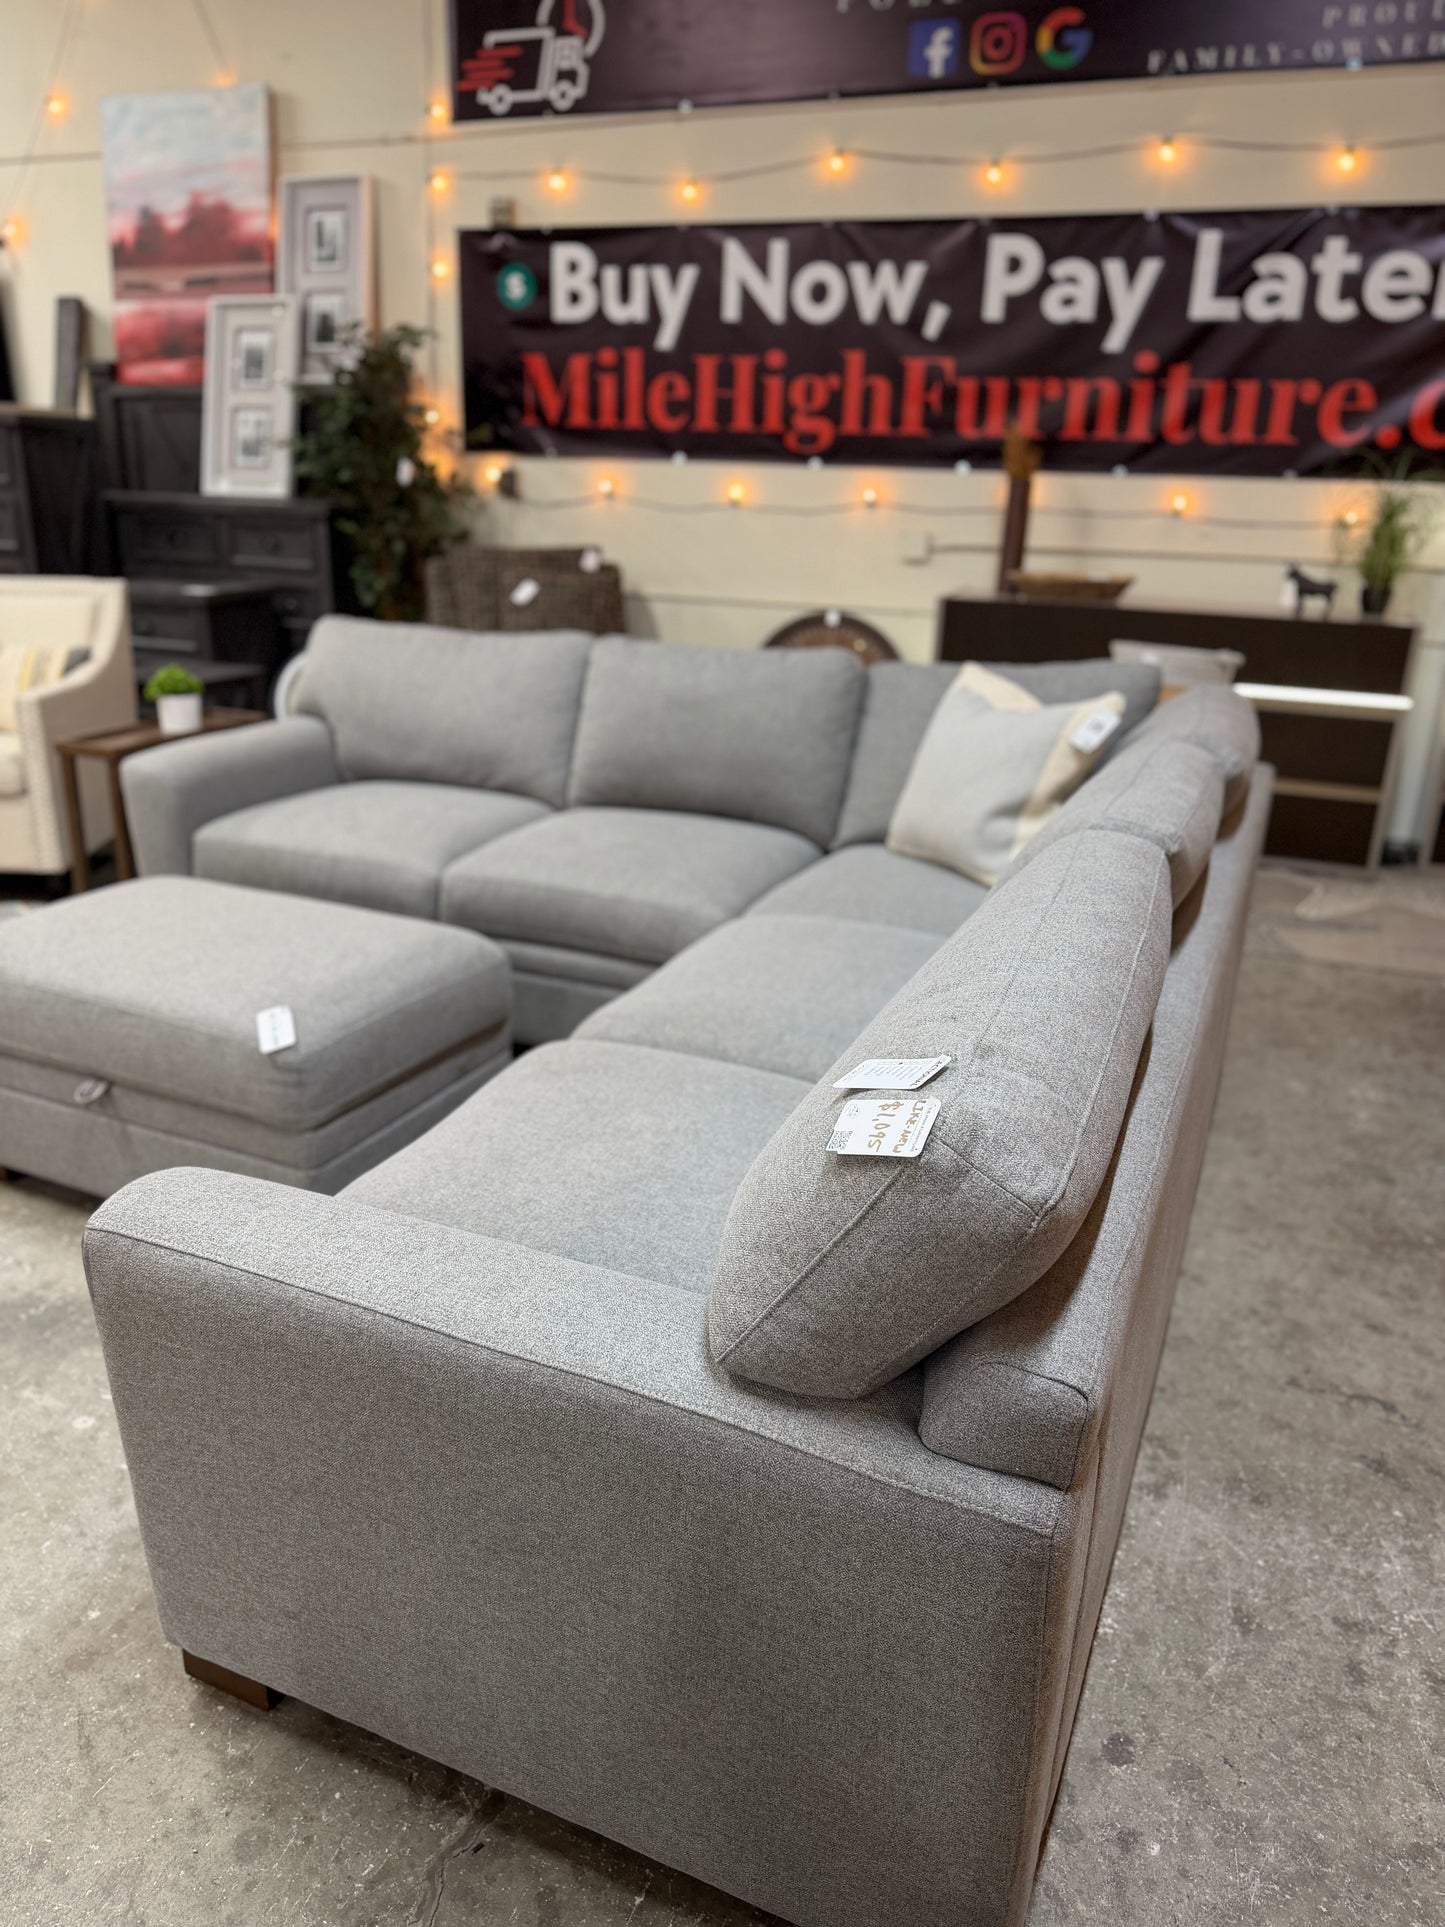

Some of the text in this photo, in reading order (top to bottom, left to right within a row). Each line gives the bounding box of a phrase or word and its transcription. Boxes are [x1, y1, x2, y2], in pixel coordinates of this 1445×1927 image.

[549, 240, 699, 352] Buy
[719, 236, 951, 342] Now,
[980, 231, 1165, 354] Pay
[1186, 227, 1445, 324] Late
[866, 1100, 905, 1153] $1,095
[892, 1099, 927, 1154] LIKE-NEW
